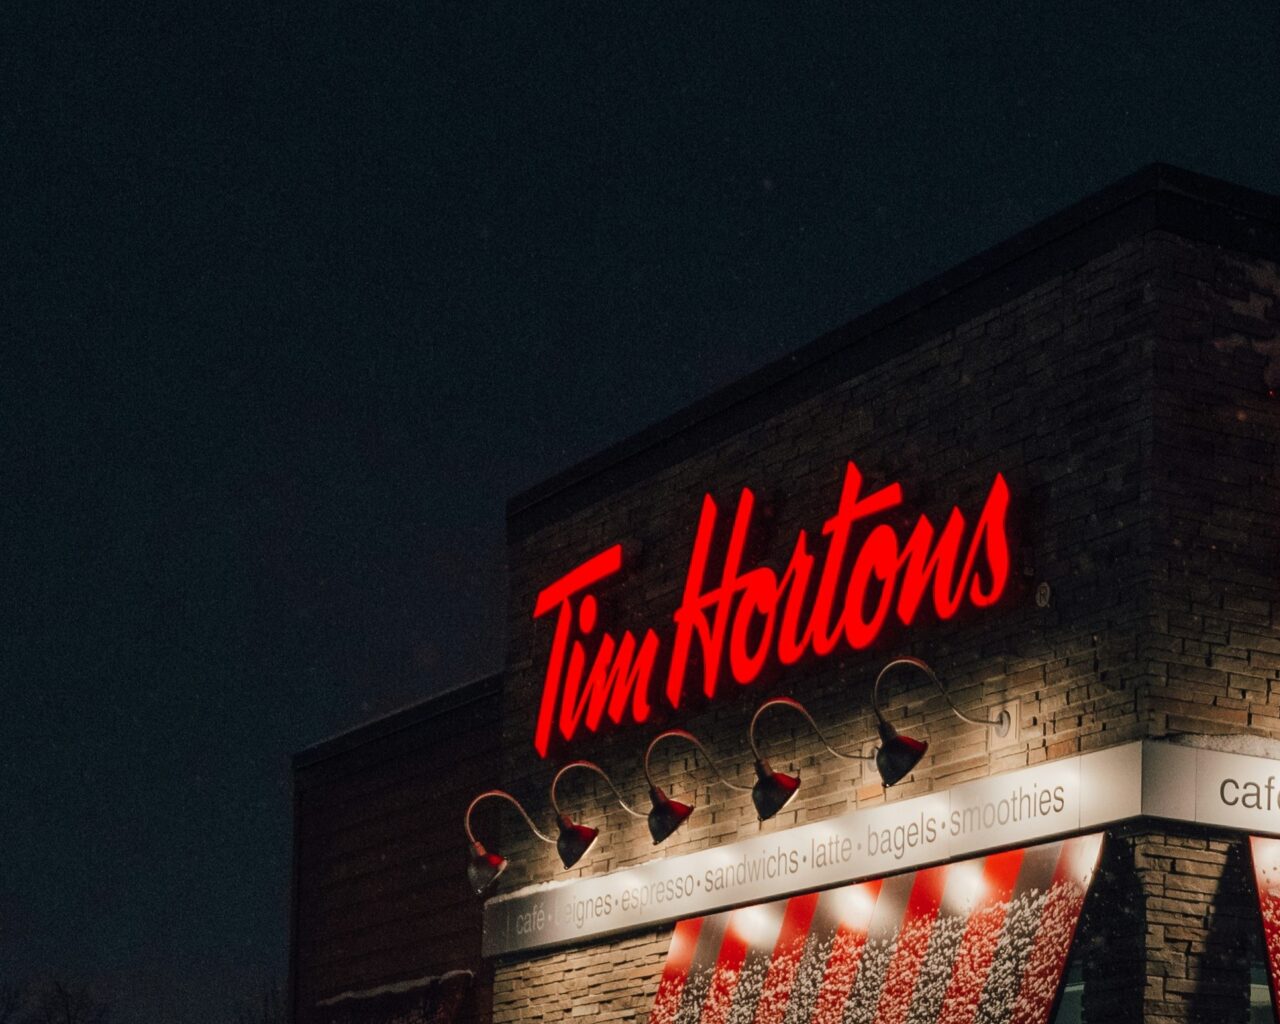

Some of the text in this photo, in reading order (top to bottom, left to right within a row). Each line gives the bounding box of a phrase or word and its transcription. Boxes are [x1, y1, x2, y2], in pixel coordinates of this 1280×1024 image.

[533, 460, 1010, 759] Tim Hortons
[515, 902, 545, 935] café
[621, 873, 694, 915] espresso
[704, 846, 798, 893] sandwichs
[811, 833, 852, 869] latte
[867, 812, 937, 860] bagels
[950, 783, 1065, 837] smoothies
